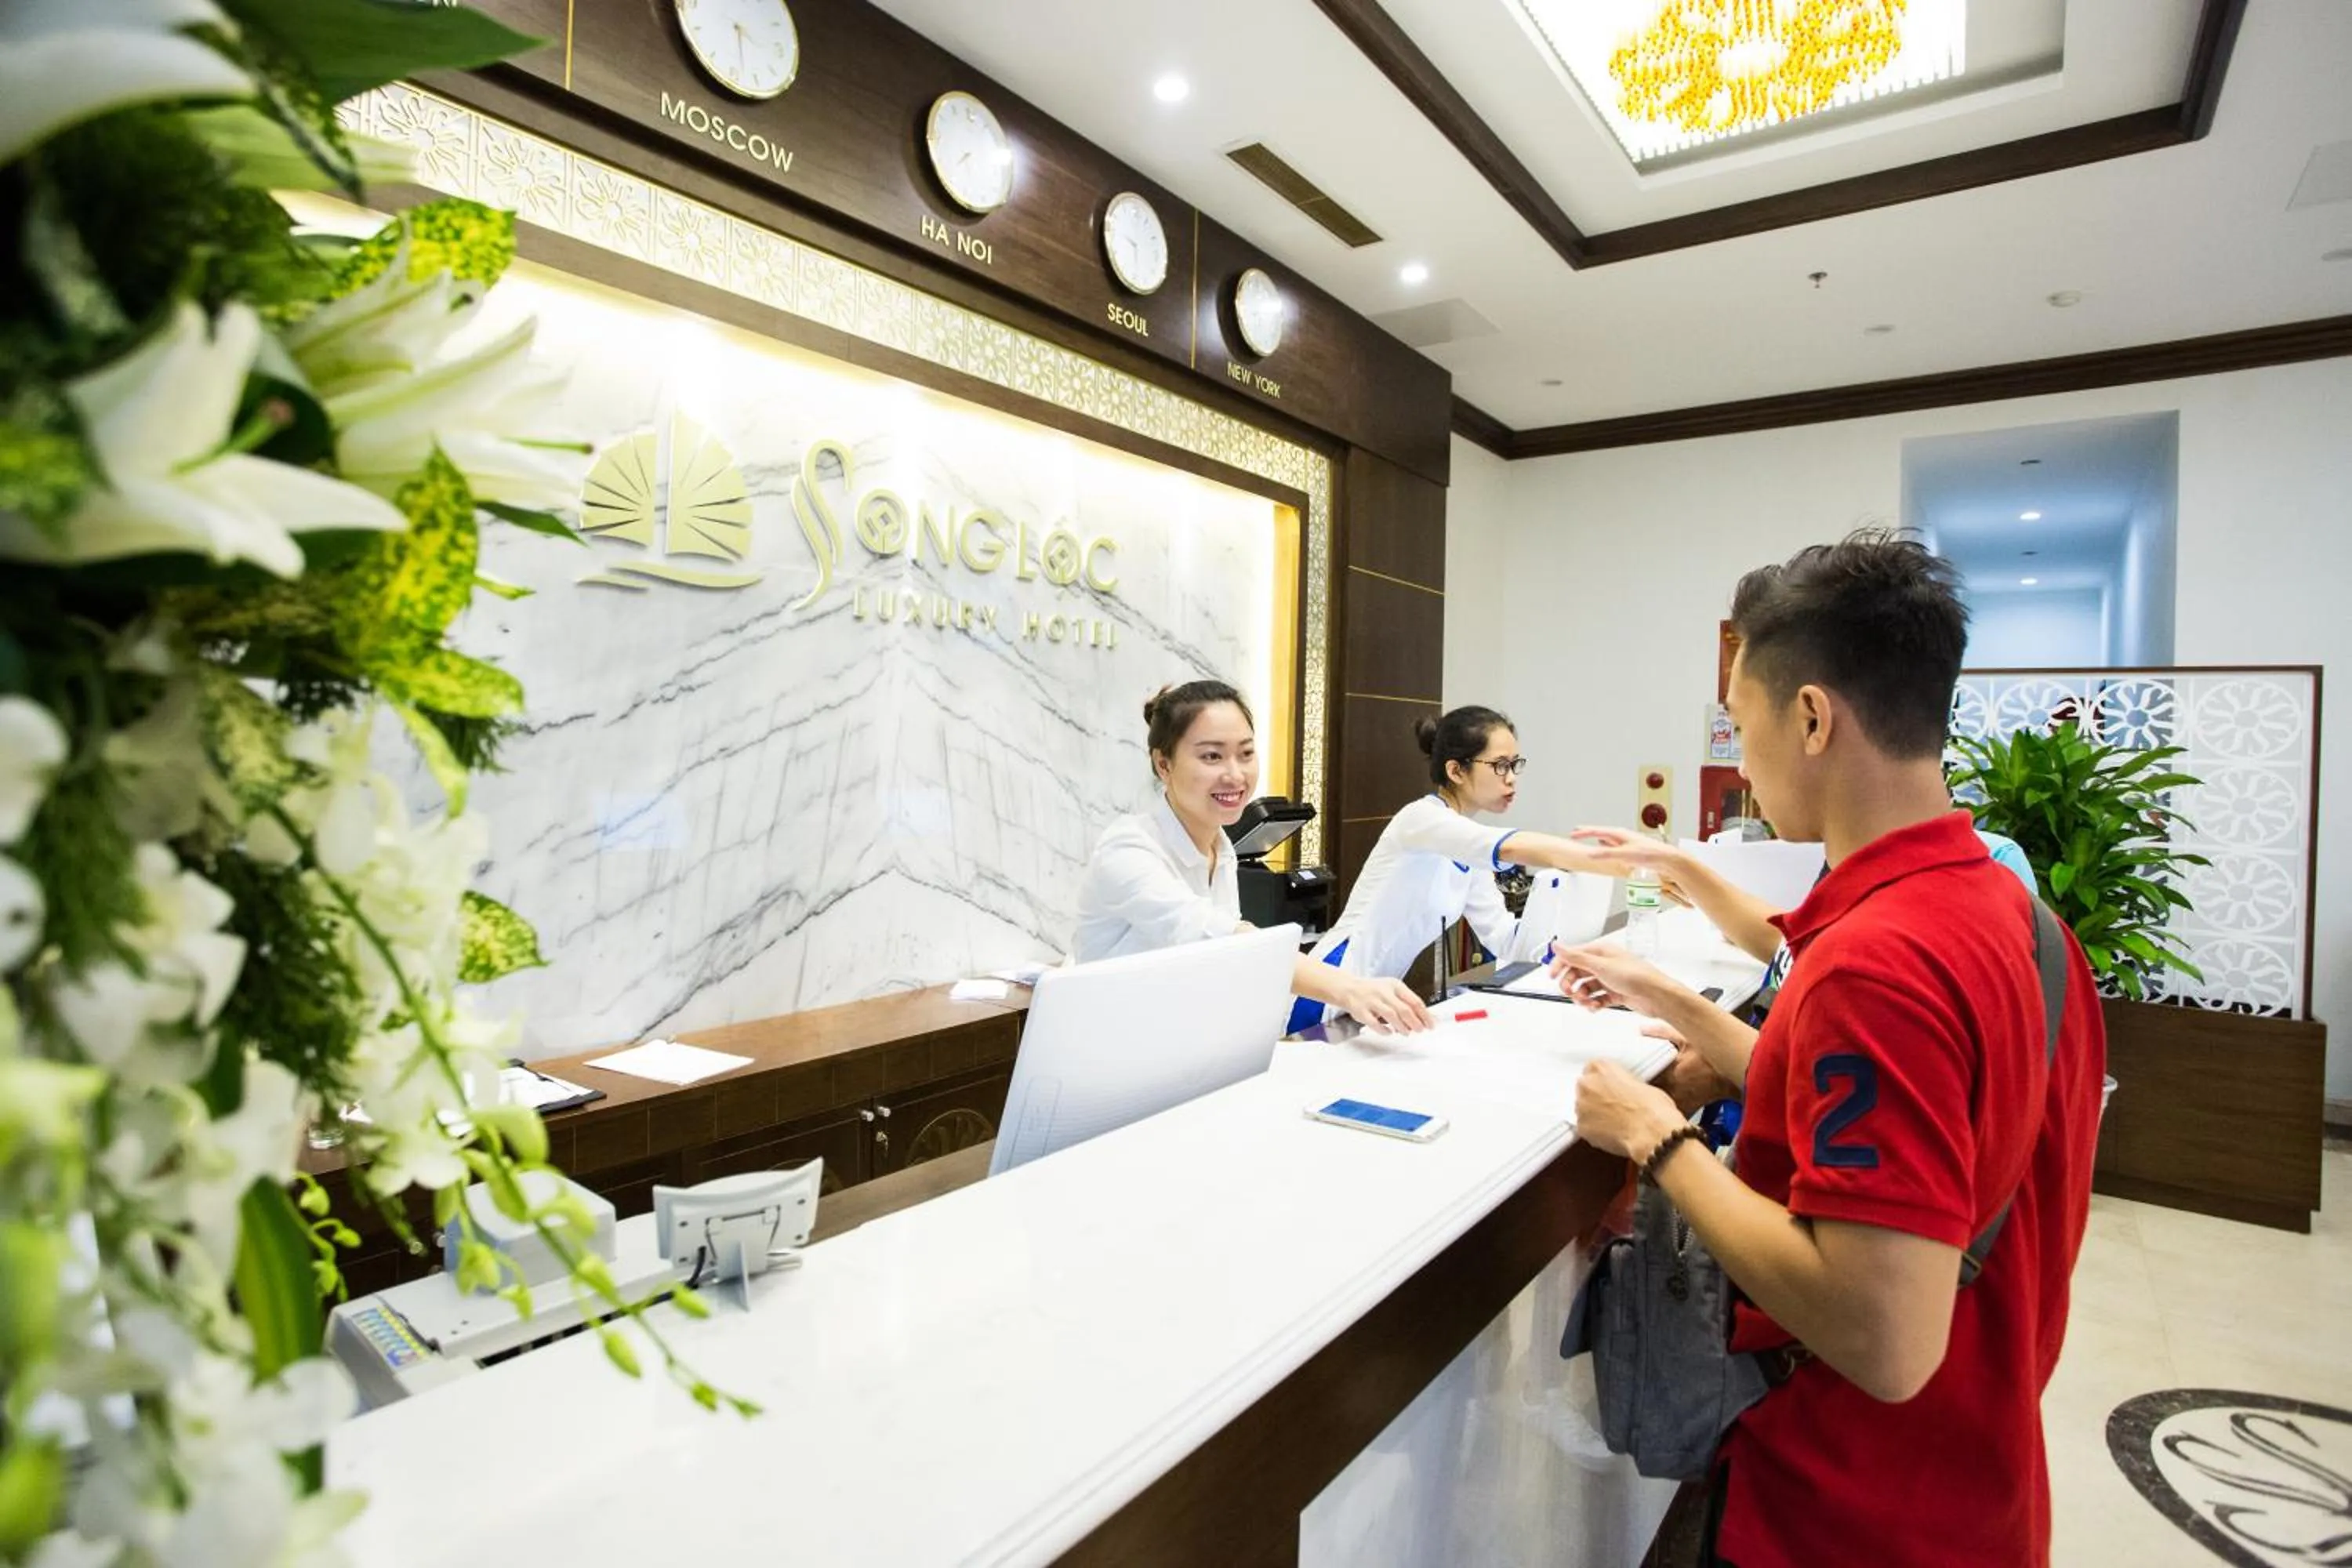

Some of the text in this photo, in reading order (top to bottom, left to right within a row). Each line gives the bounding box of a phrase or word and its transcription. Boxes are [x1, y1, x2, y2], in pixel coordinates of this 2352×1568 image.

[661, 91, 793, 172] MOSCOW
[921, 215, 992, 264] HA NOI
[1107, 303, 1149, 337] SEOUL
[1227, 361, 1281, 399] NEW YORK
[853, 587, 1117, 650] LUXURY HOTEL
[1813, 1054, 1879, 1167] 2
